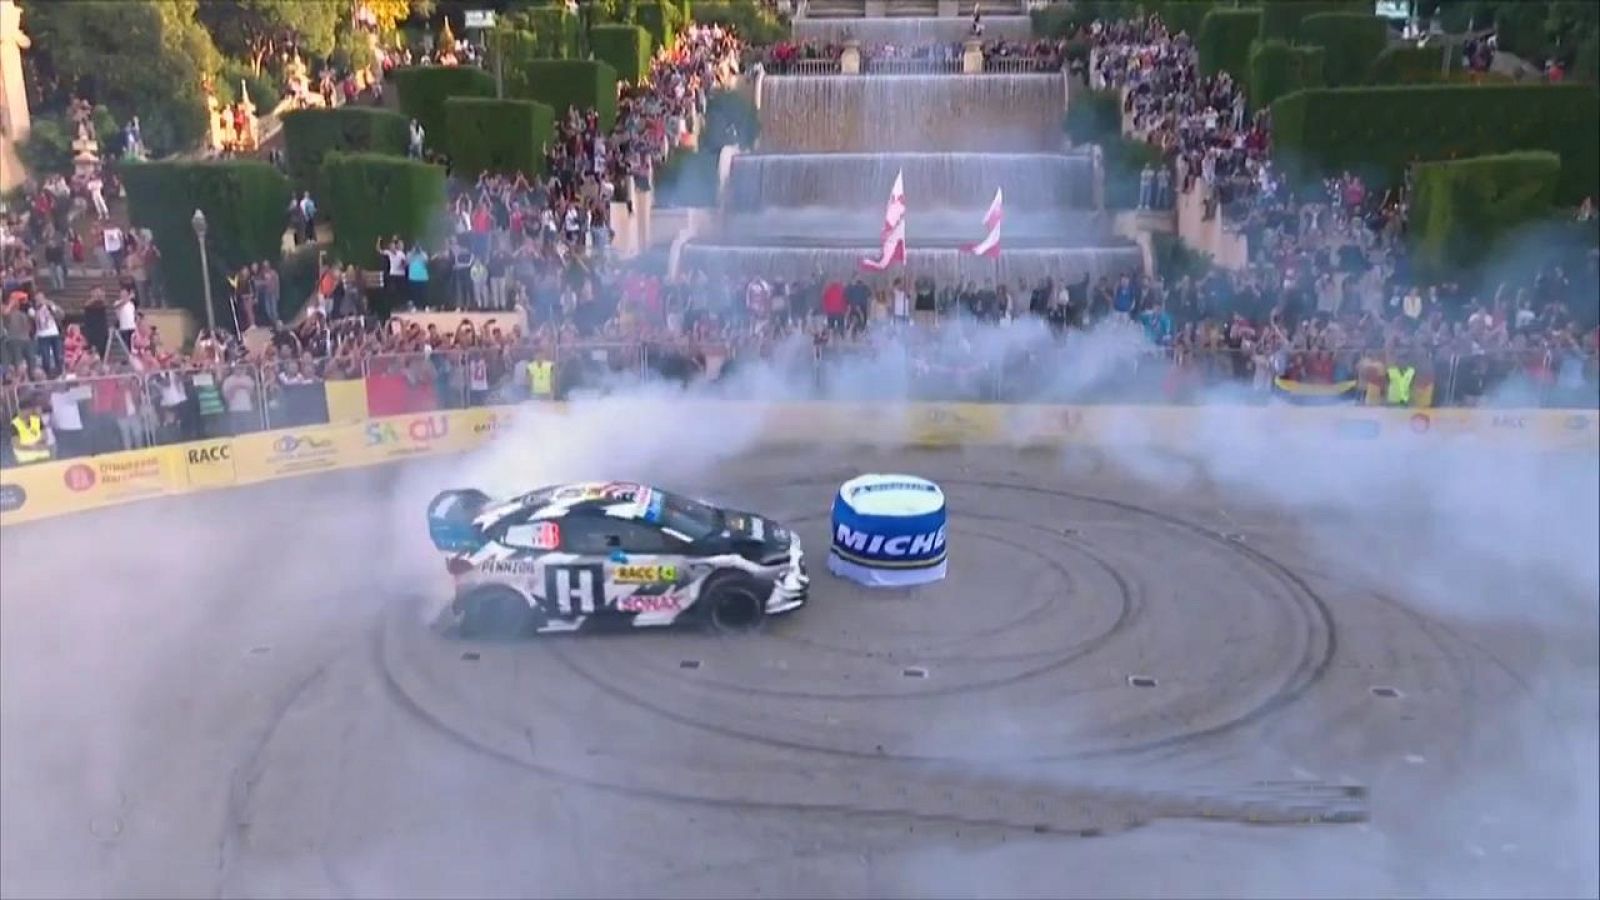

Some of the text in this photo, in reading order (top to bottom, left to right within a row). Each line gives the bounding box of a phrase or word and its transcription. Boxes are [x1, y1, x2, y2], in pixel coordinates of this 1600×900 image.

[188, 444, 231, 464] RACC
[618, 566, 659, 580] RACC
[556, 569, 595, 613] H
